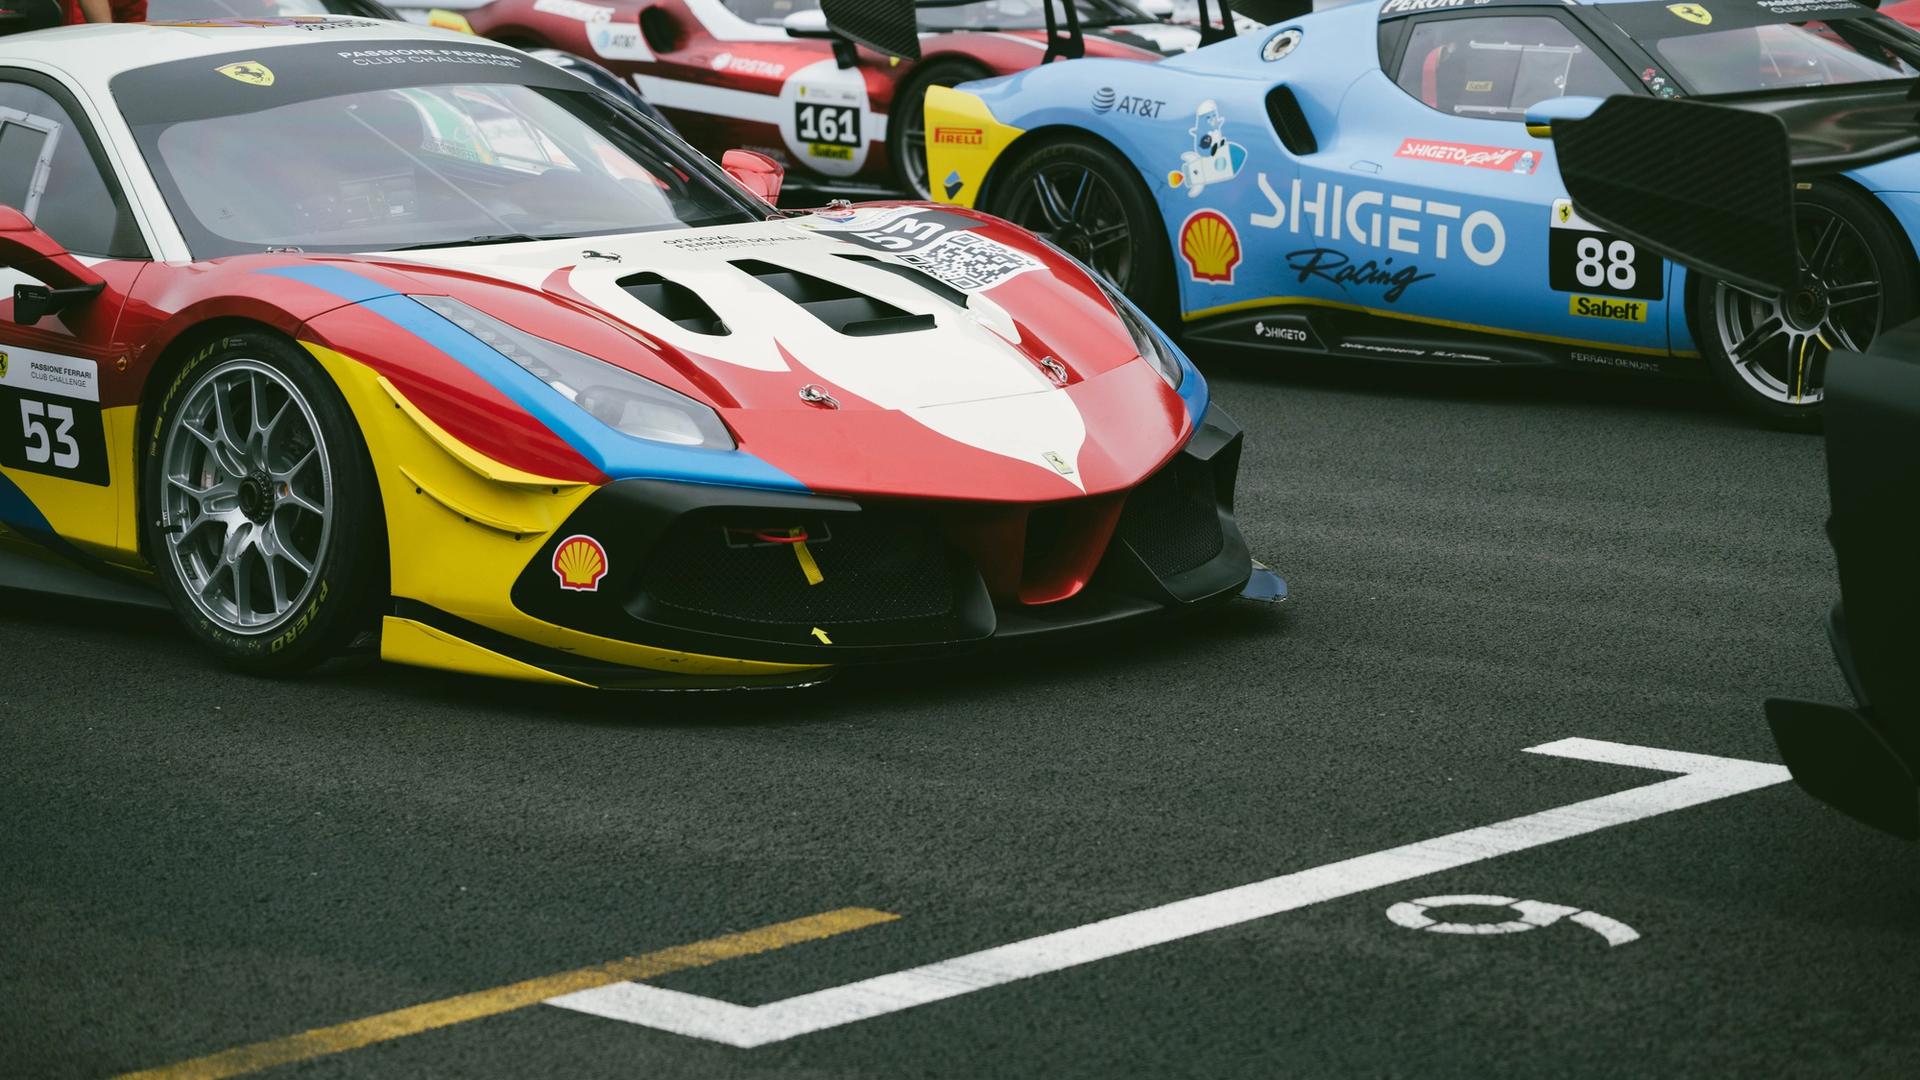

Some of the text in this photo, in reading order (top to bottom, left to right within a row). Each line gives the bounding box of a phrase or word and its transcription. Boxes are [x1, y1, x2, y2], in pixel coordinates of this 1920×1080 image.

[338, 48, 523, 63] PASSIONE FERRARI
[352, 54, 521, 69] CLUB CHALLENGE
[1117, 96, 1166, 119] AT&T
[799, 105, 858, 143] 161
[934, 127, 984, 145] PIRELLI
[1402, 143, 1466, 160] SHIGETO
[1249, 172, 1507, 266] SHIGETO
[663, 235, 739, 245] OFFICIAL
[675, 238, 745, 249] FERRARI
[1575, 236, 1637, 290] 88
[1285, 247, 1437, 303] Racing
[1577, 297, 1639, 321] Sabelt
[1264, 326, 1307, 342] SHIGETO
[1570, 352, 1613, 366] FERRARI
[30, 362, 92, 380] PASSIONE FERRARI
[30, 371, 87, 388] CLUB CHALLENGE
[163, 343, 216, 413] PIRELLI
[20, 398, 80, 470] 53
